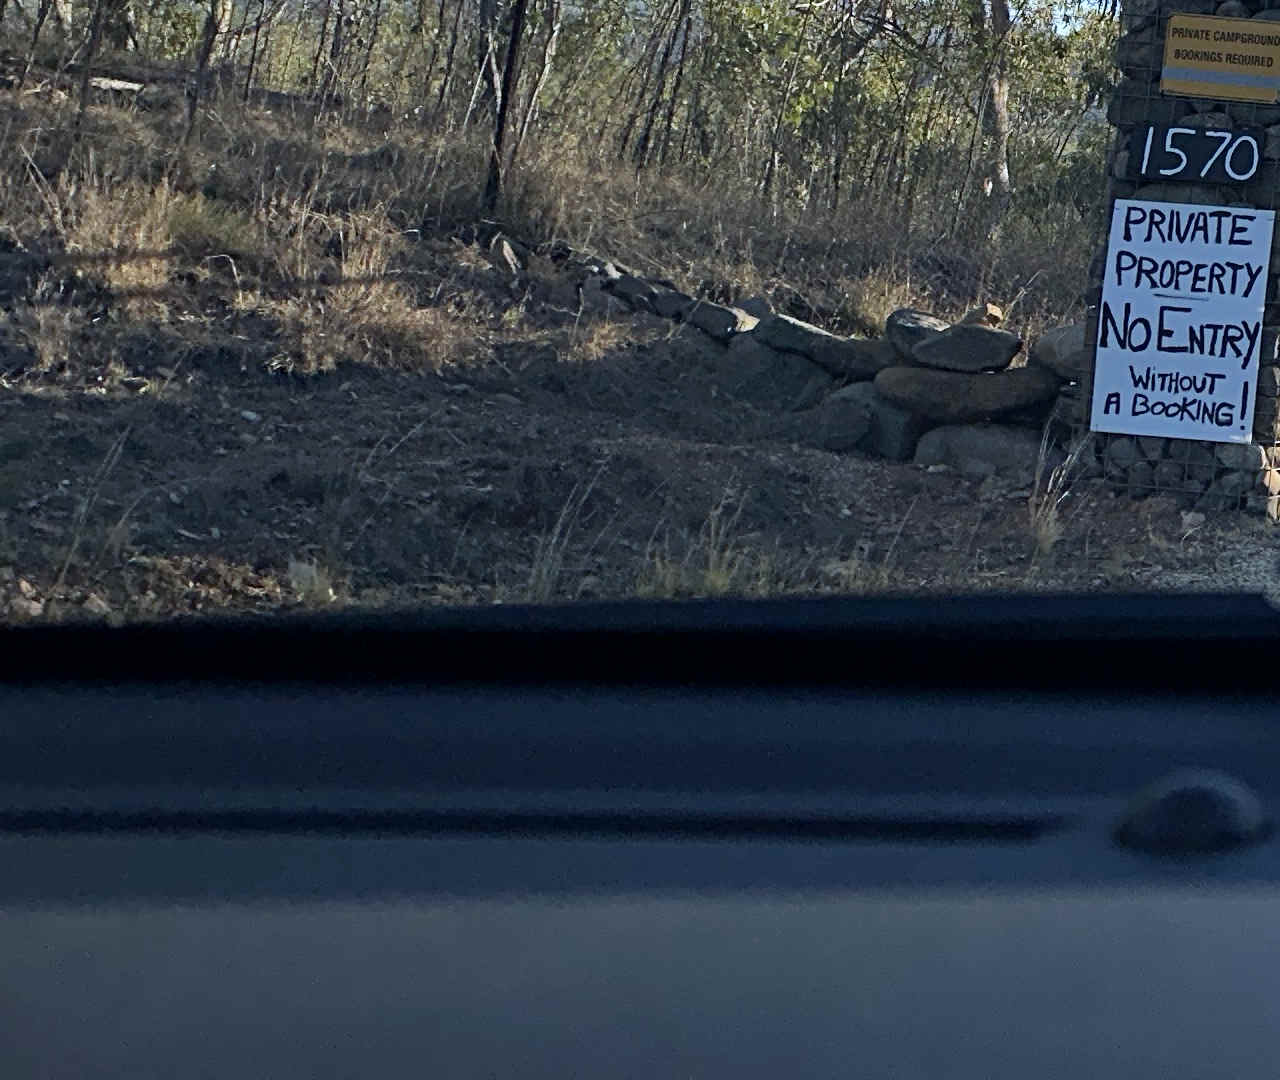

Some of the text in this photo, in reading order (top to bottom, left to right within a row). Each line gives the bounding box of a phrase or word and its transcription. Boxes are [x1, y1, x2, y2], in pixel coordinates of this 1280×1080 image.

[1171, 27, 1280, 46] PRIVATE CAMPGROUND
[1174, 48, 1274, 67] BOOKINGS REQUIRED
[1141, 126, 1259, 180] 1570
[1122, 206, 1256, 246] PRIVATE
[1116, 251, 1263, 298] PROPERTY
[1099, 301, 1261, 369] NO ENTRY
[1103, 393, 1121, 415] A
